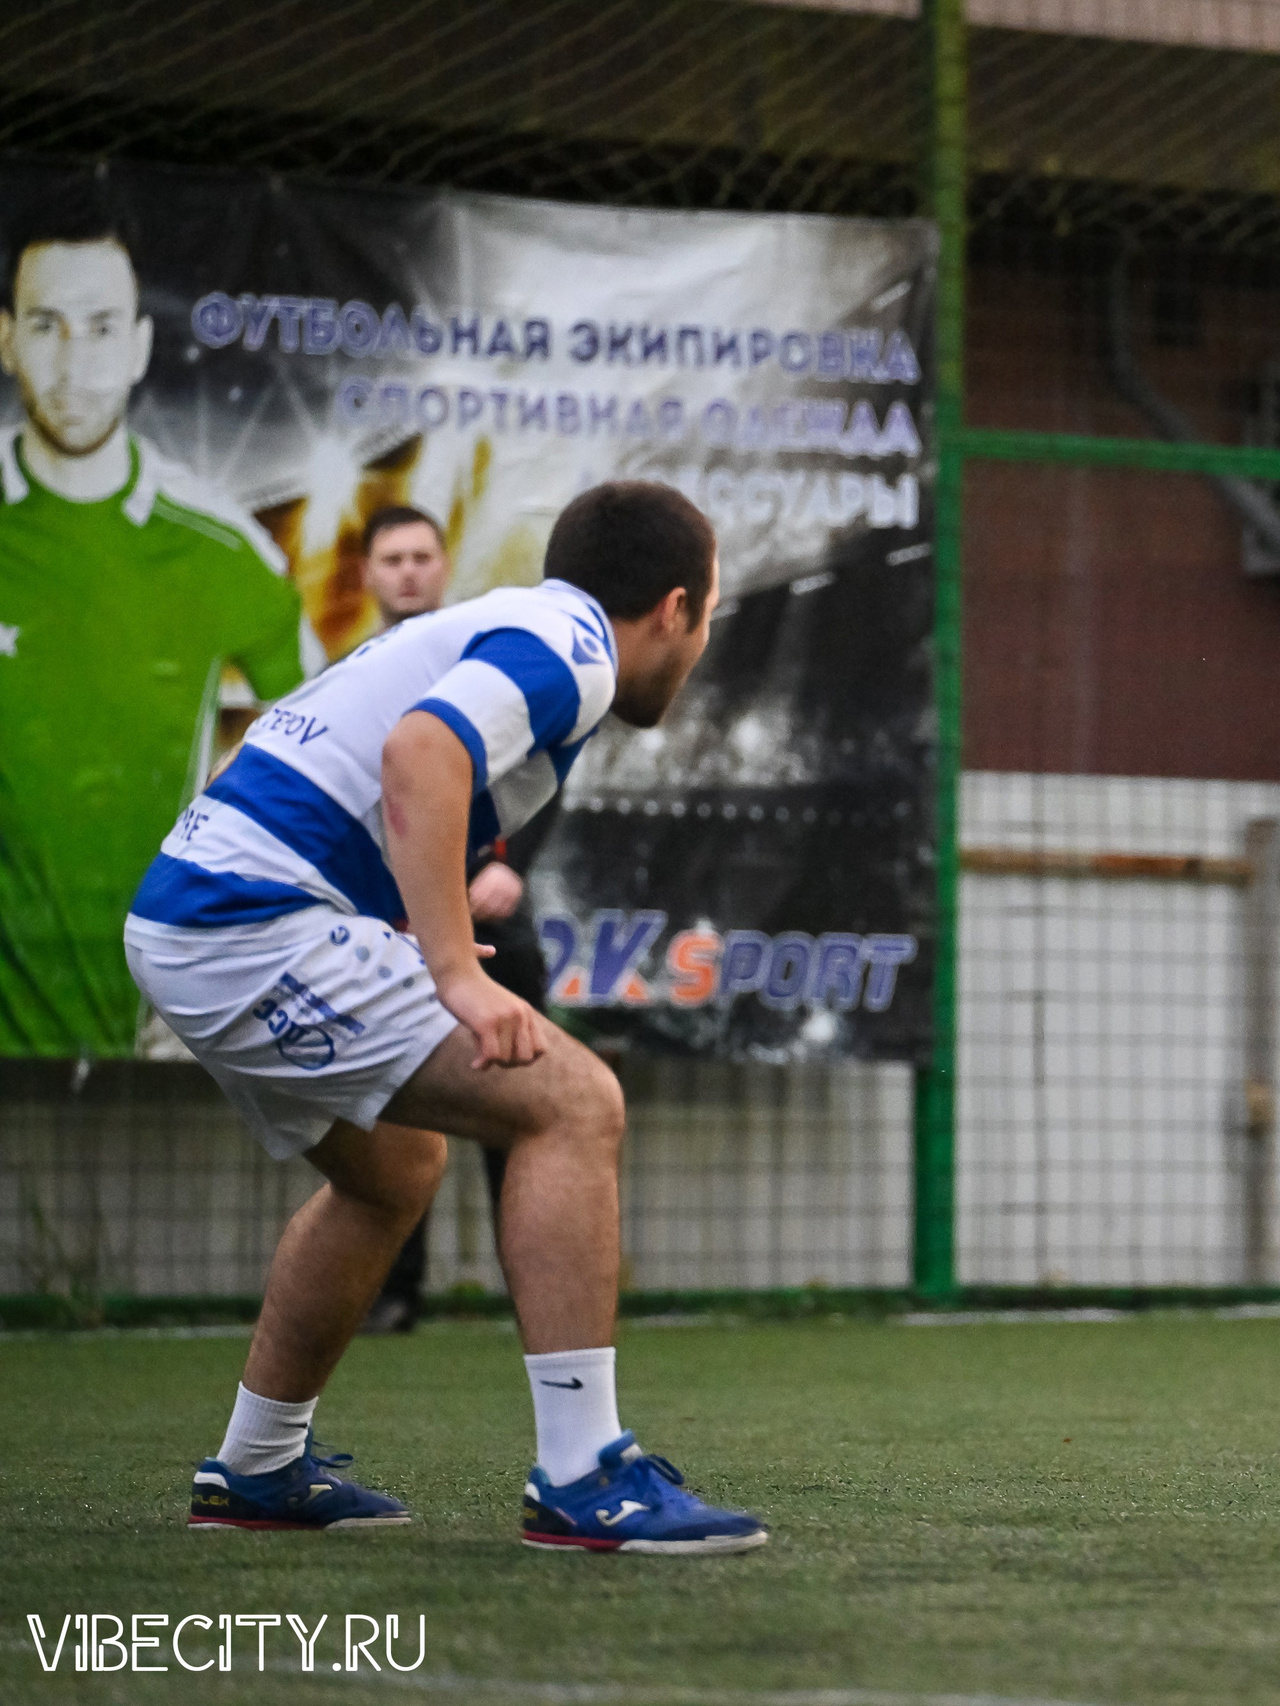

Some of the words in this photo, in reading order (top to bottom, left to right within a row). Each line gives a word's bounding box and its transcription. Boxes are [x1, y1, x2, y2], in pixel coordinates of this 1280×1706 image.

[190, 291, 551, 360] ФУТБОЛЬНАЯ
[568, 317, 922, 386] ЭКИПИРОВКА
[334, 374, 685, 440] СПОРТИВНАЯ
